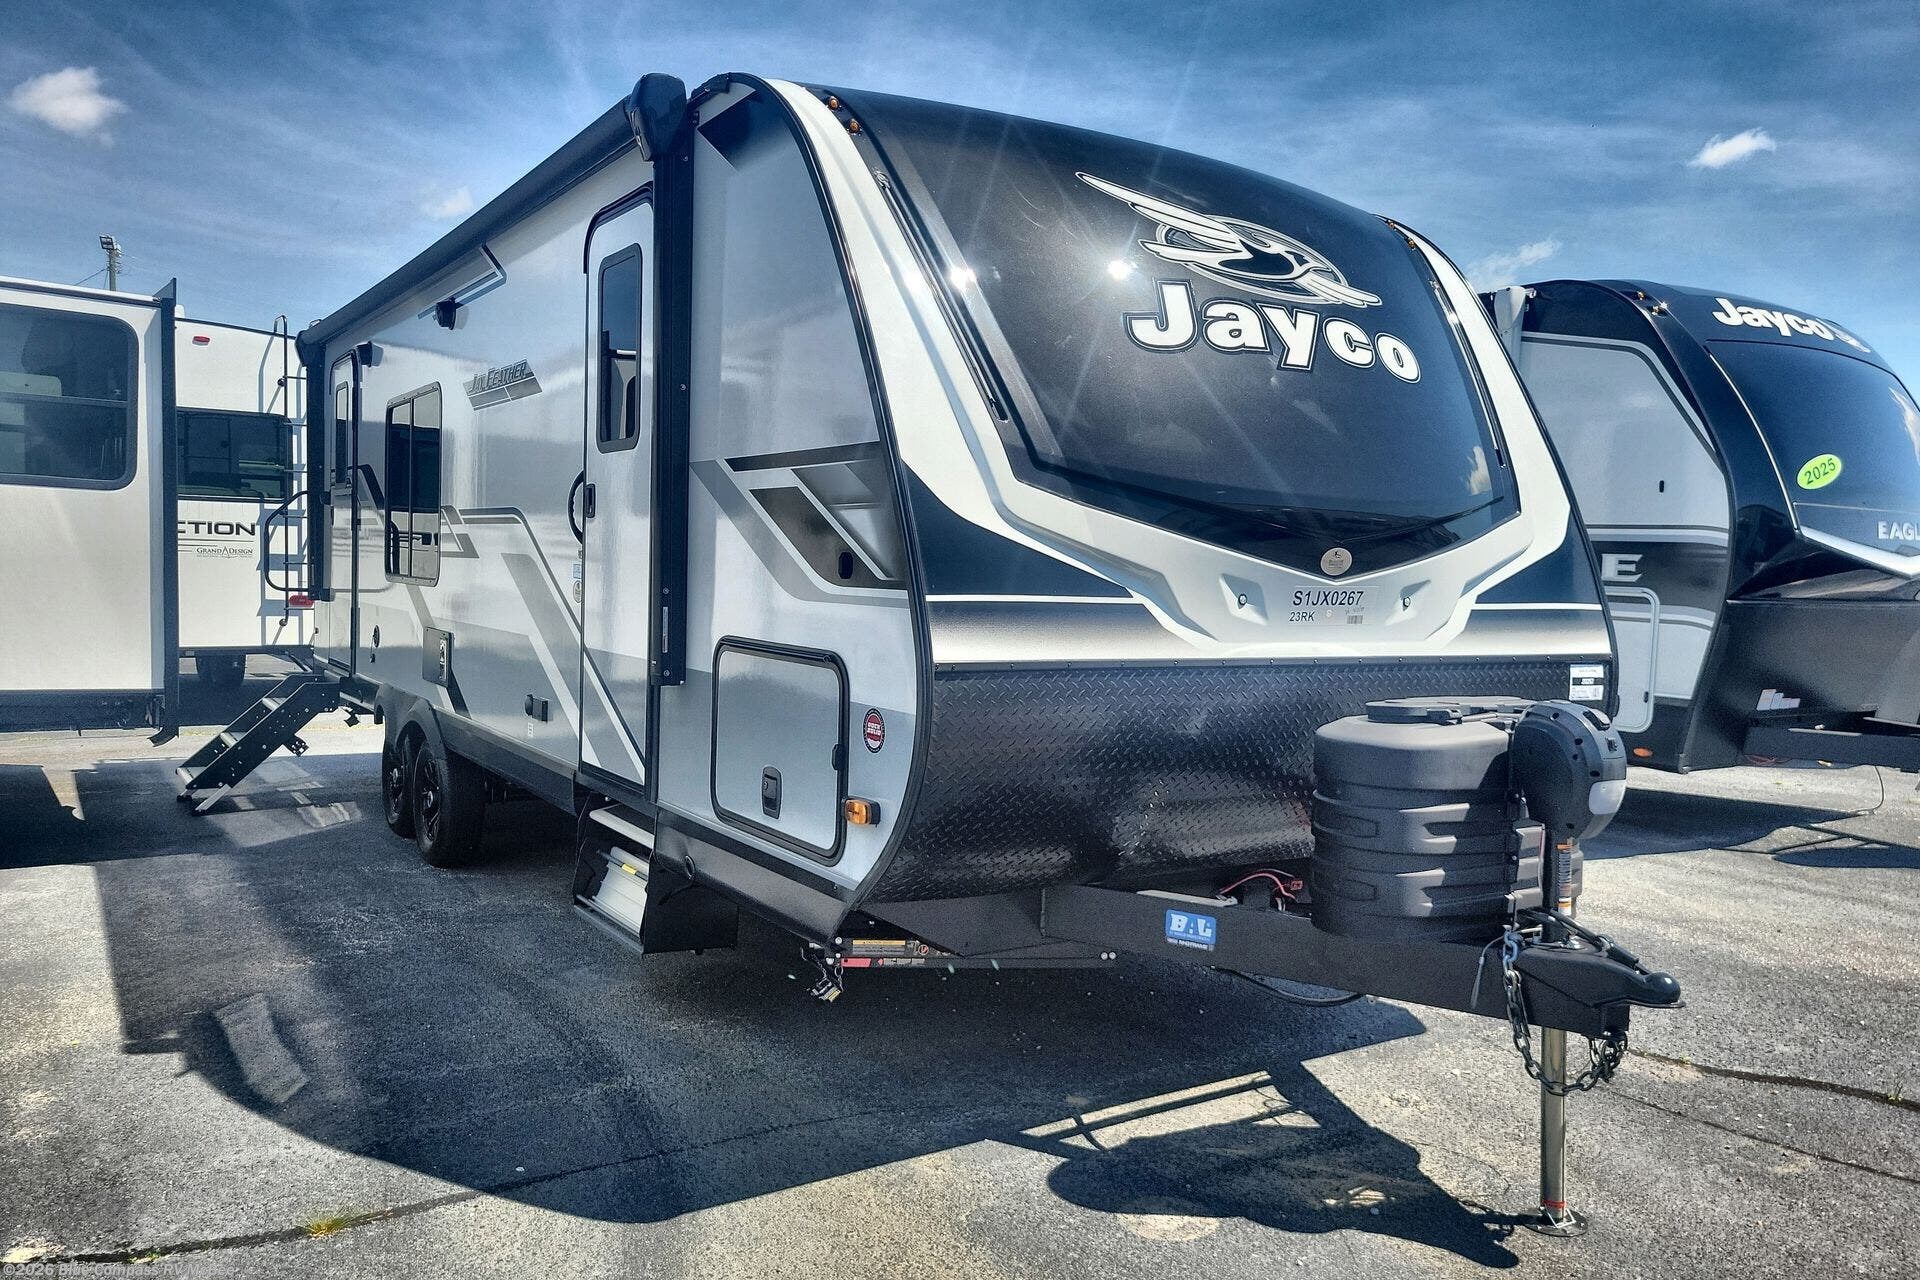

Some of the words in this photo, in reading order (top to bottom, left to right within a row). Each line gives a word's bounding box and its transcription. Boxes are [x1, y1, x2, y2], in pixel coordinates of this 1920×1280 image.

[1122, 279, 1421, 384] Jayco
[1712, 297, 1834, 341] Jayco
[1804, 458, 1836, 485] 2025
[1293, 590, 1364, 606] S1JX0267
[1289, 611, 1315, 622] 23RK
